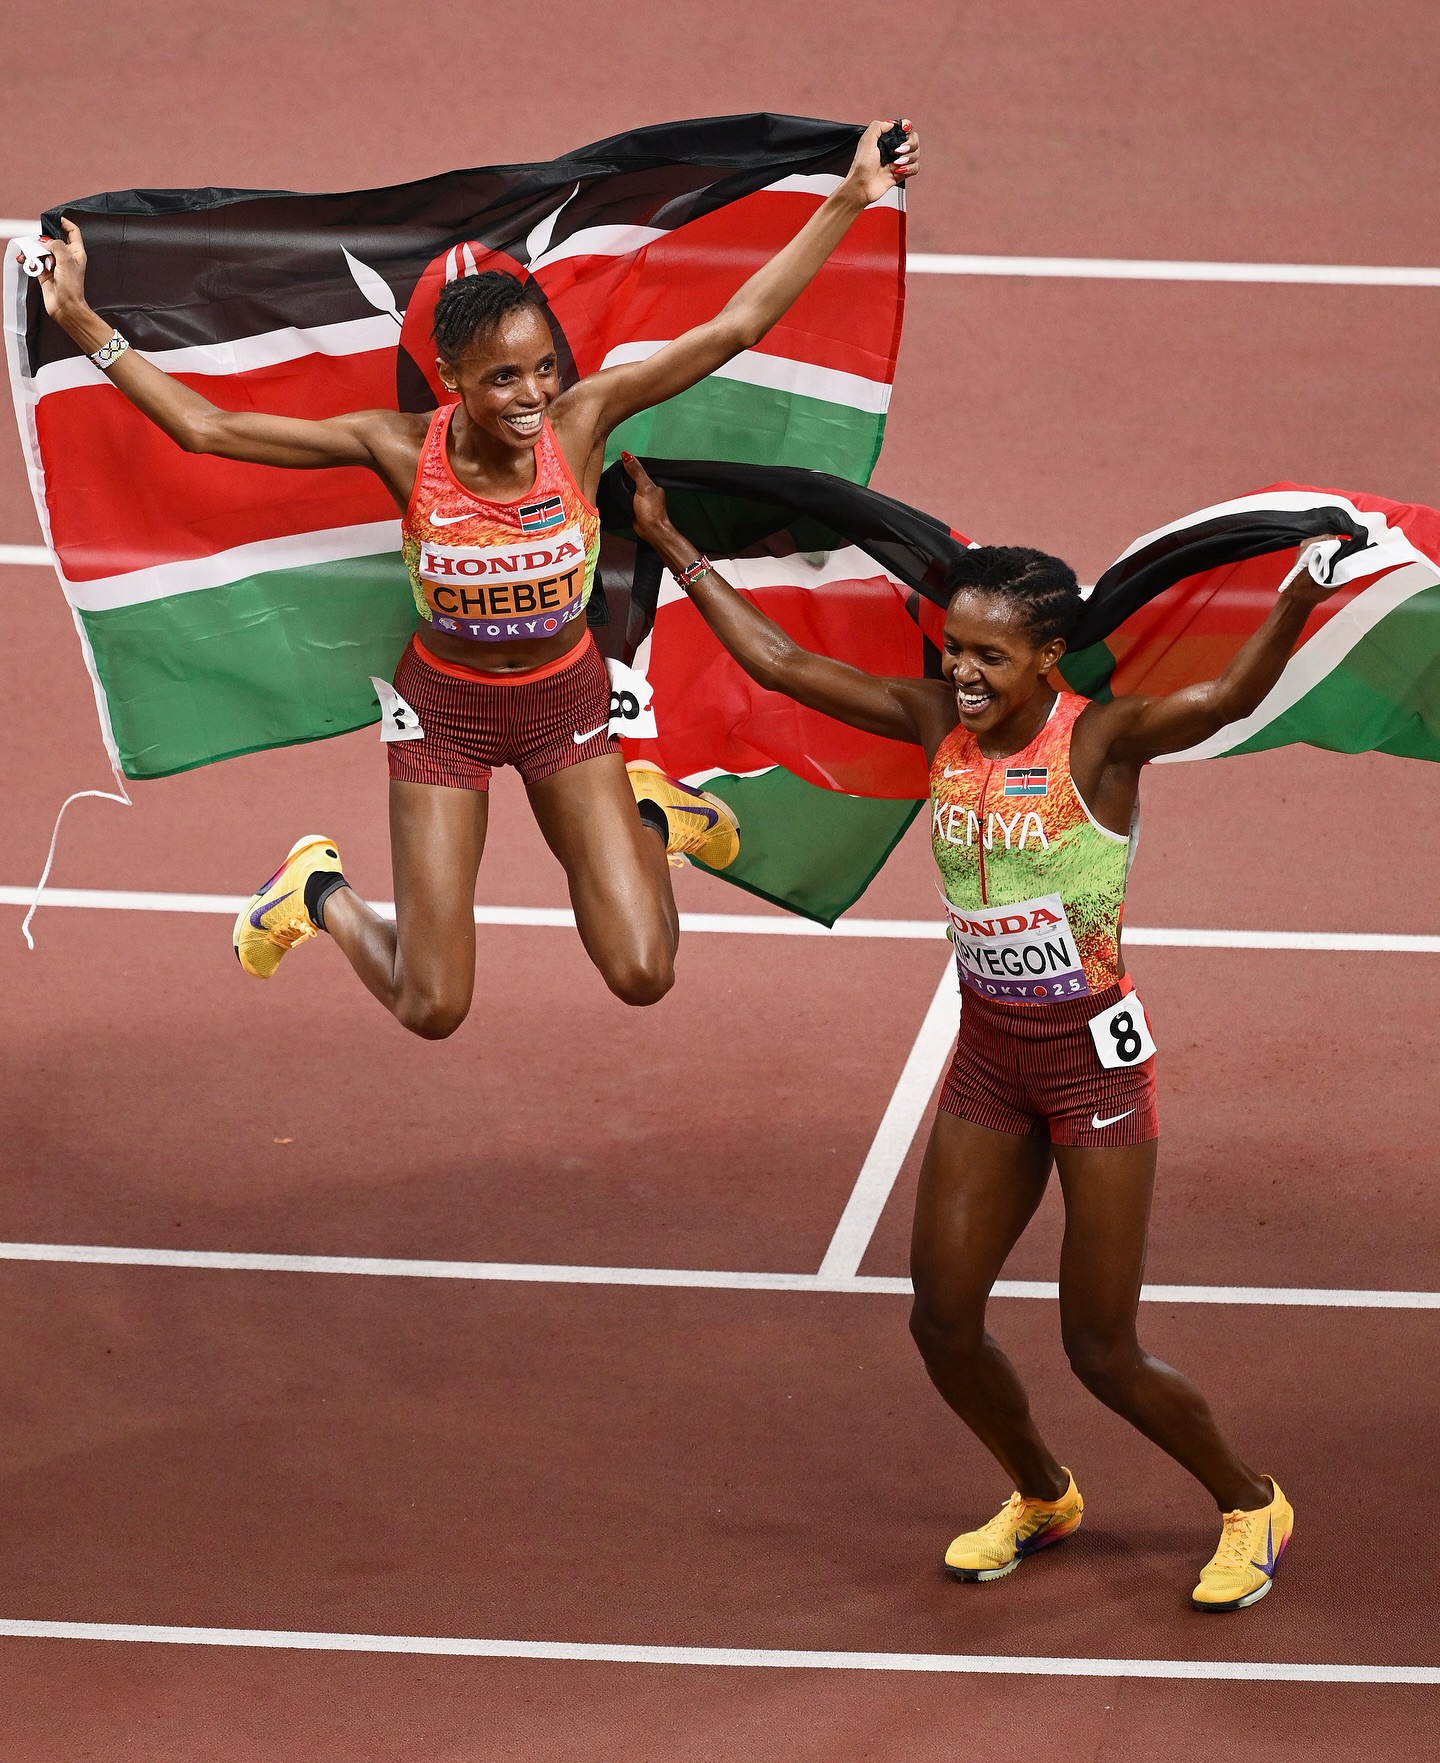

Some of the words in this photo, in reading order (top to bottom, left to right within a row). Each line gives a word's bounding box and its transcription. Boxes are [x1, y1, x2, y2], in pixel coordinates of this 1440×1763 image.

[424, 542, 582, 576] HONDA
[433, 568, 579, 616] CHEBET
[932, 798, 1049, 850] KENYA
[944, 904, 1063, 937] ONDA
[1053, 978, 1080, 996] 25
[1109, 1011, 1142, 1062] 8
